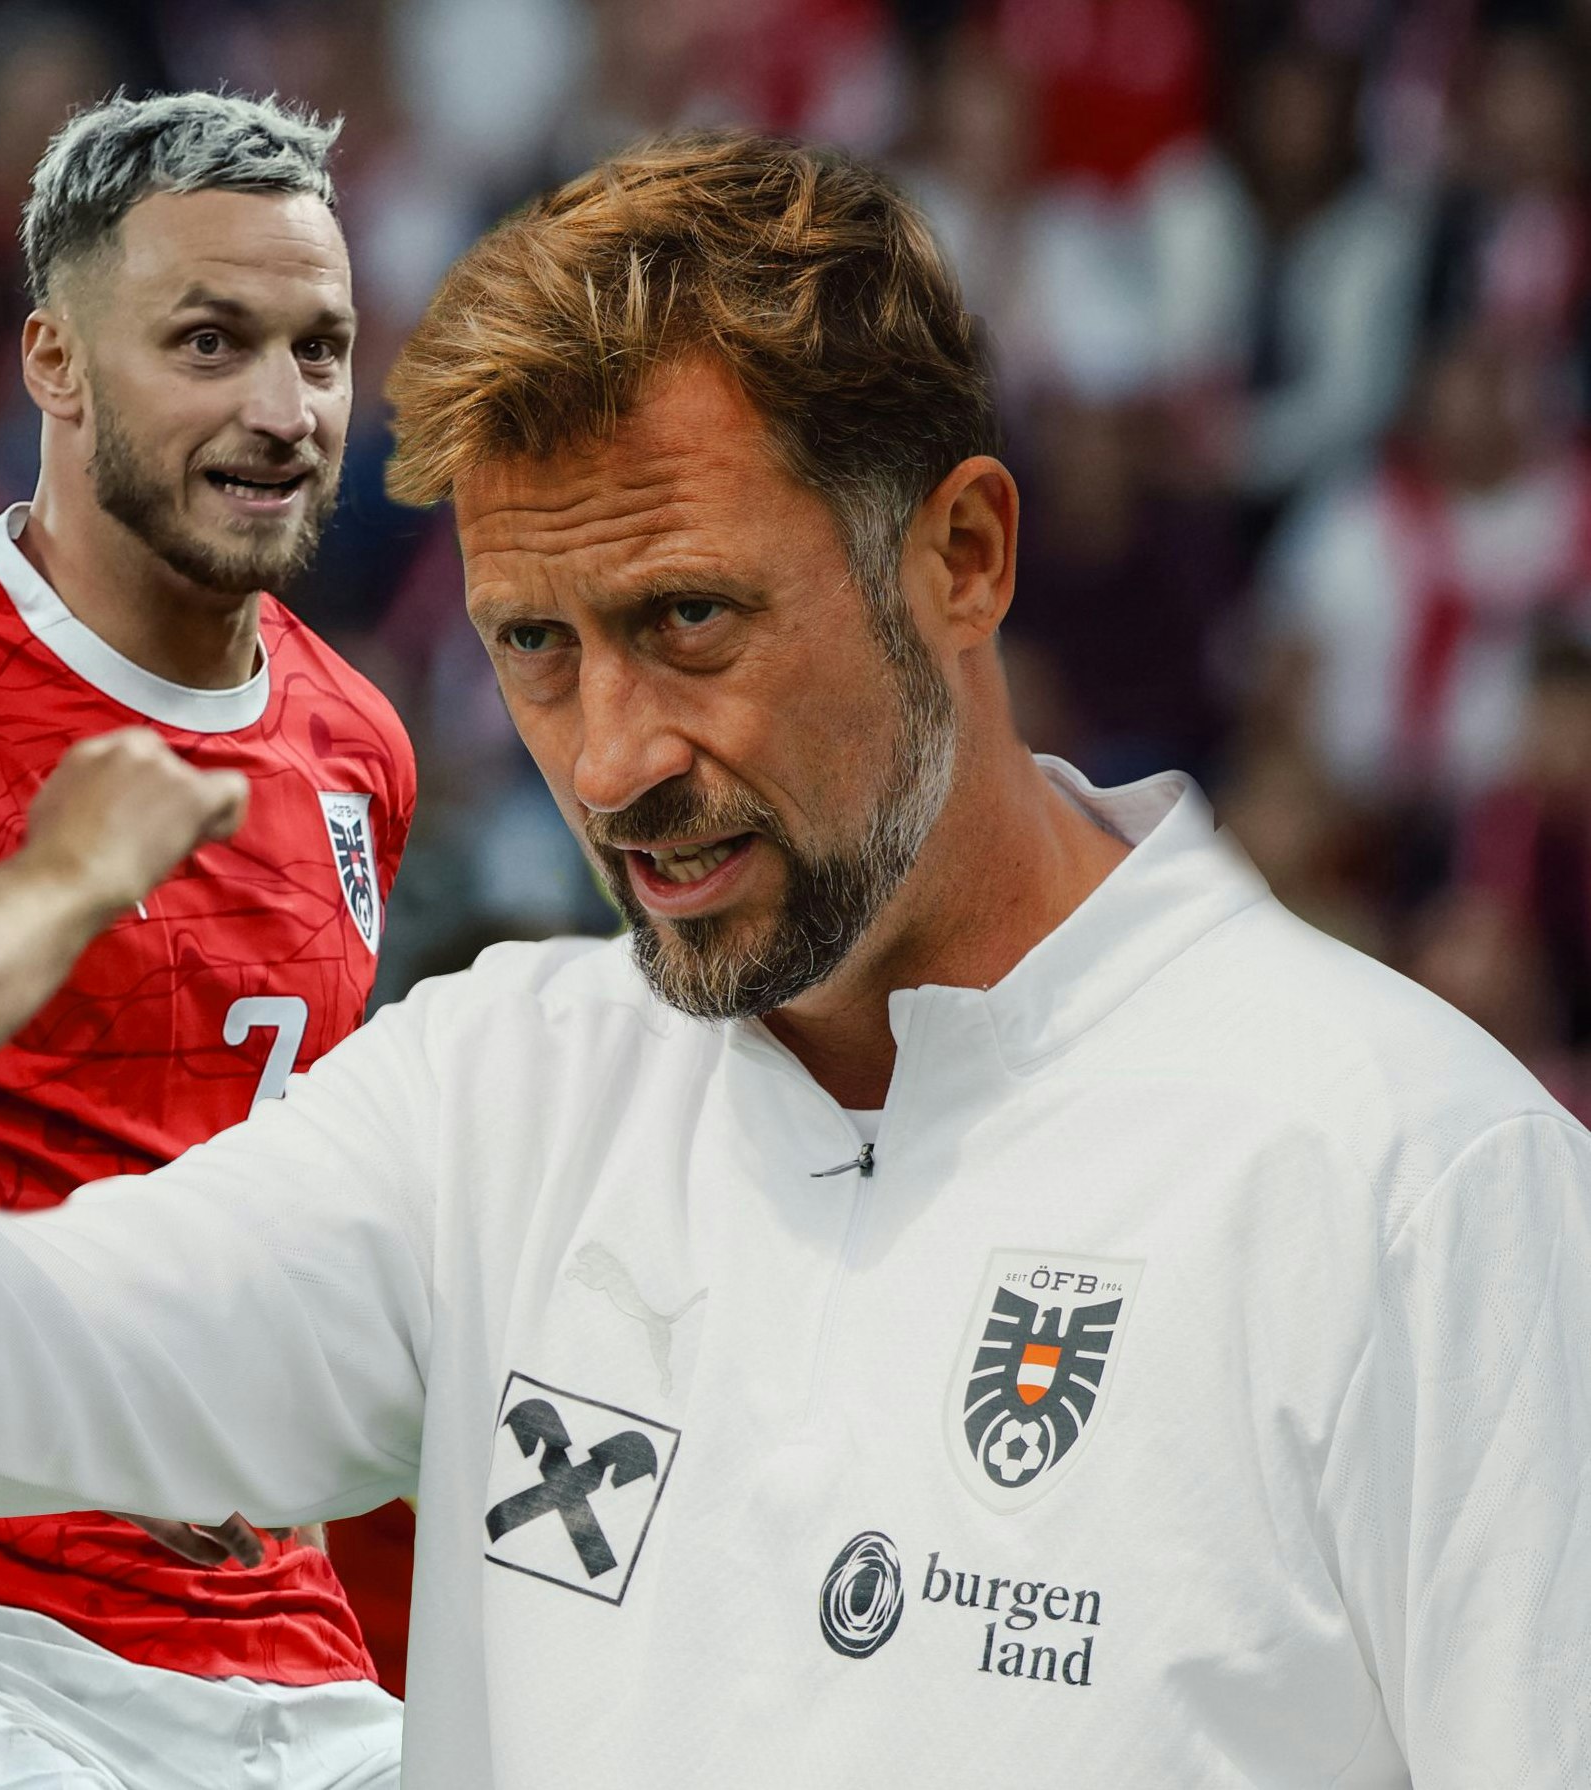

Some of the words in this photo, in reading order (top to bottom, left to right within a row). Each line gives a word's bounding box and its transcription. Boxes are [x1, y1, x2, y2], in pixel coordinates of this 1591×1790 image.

[222, 996, 308, 1120] 7
[1005, 1273, 1028, 1283] SEIT
[1030, 1265, 1098, 1294] ÖFB
[1100, 1282, 1123, 1292] 1904
[921, 1551, 1101, 1630] burgen
[977, 1621, 1094, 1686] land
